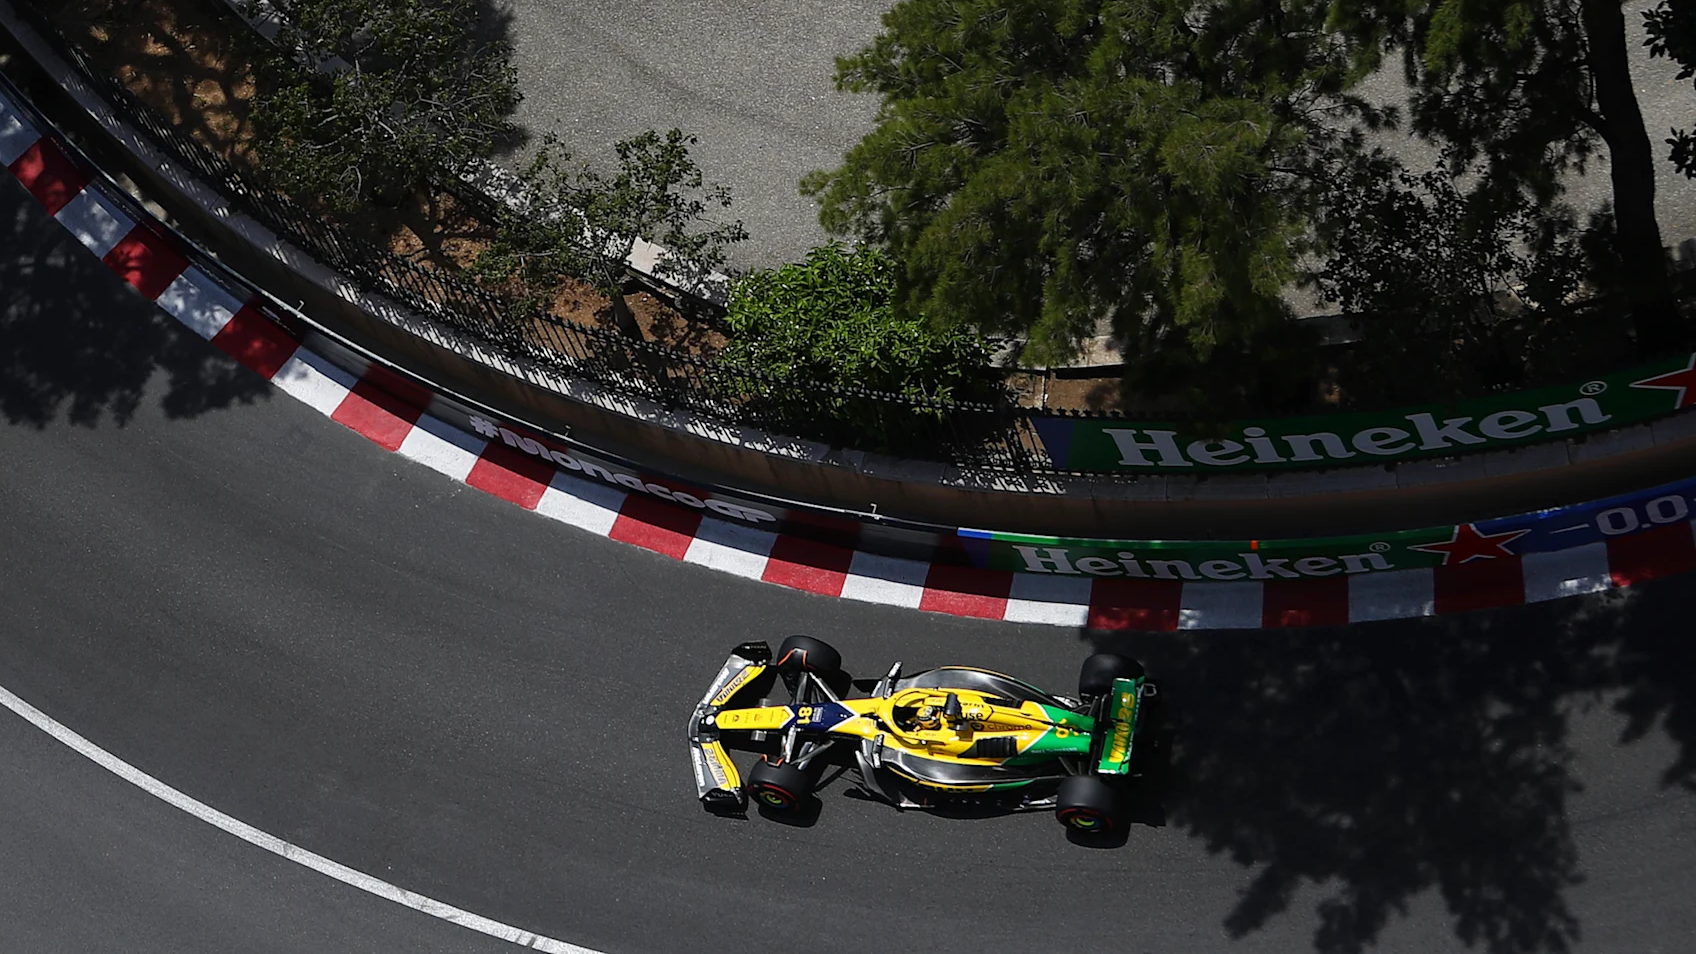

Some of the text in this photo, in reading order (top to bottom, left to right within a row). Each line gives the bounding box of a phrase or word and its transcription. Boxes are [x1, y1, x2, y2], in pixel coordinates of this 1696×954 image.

[468, 413, 778, 525] #MonacoGP
[797, 706, 812, 724] 81
[961, 711, 984, 721] use
[987, 722, 1032, 731] chrome
